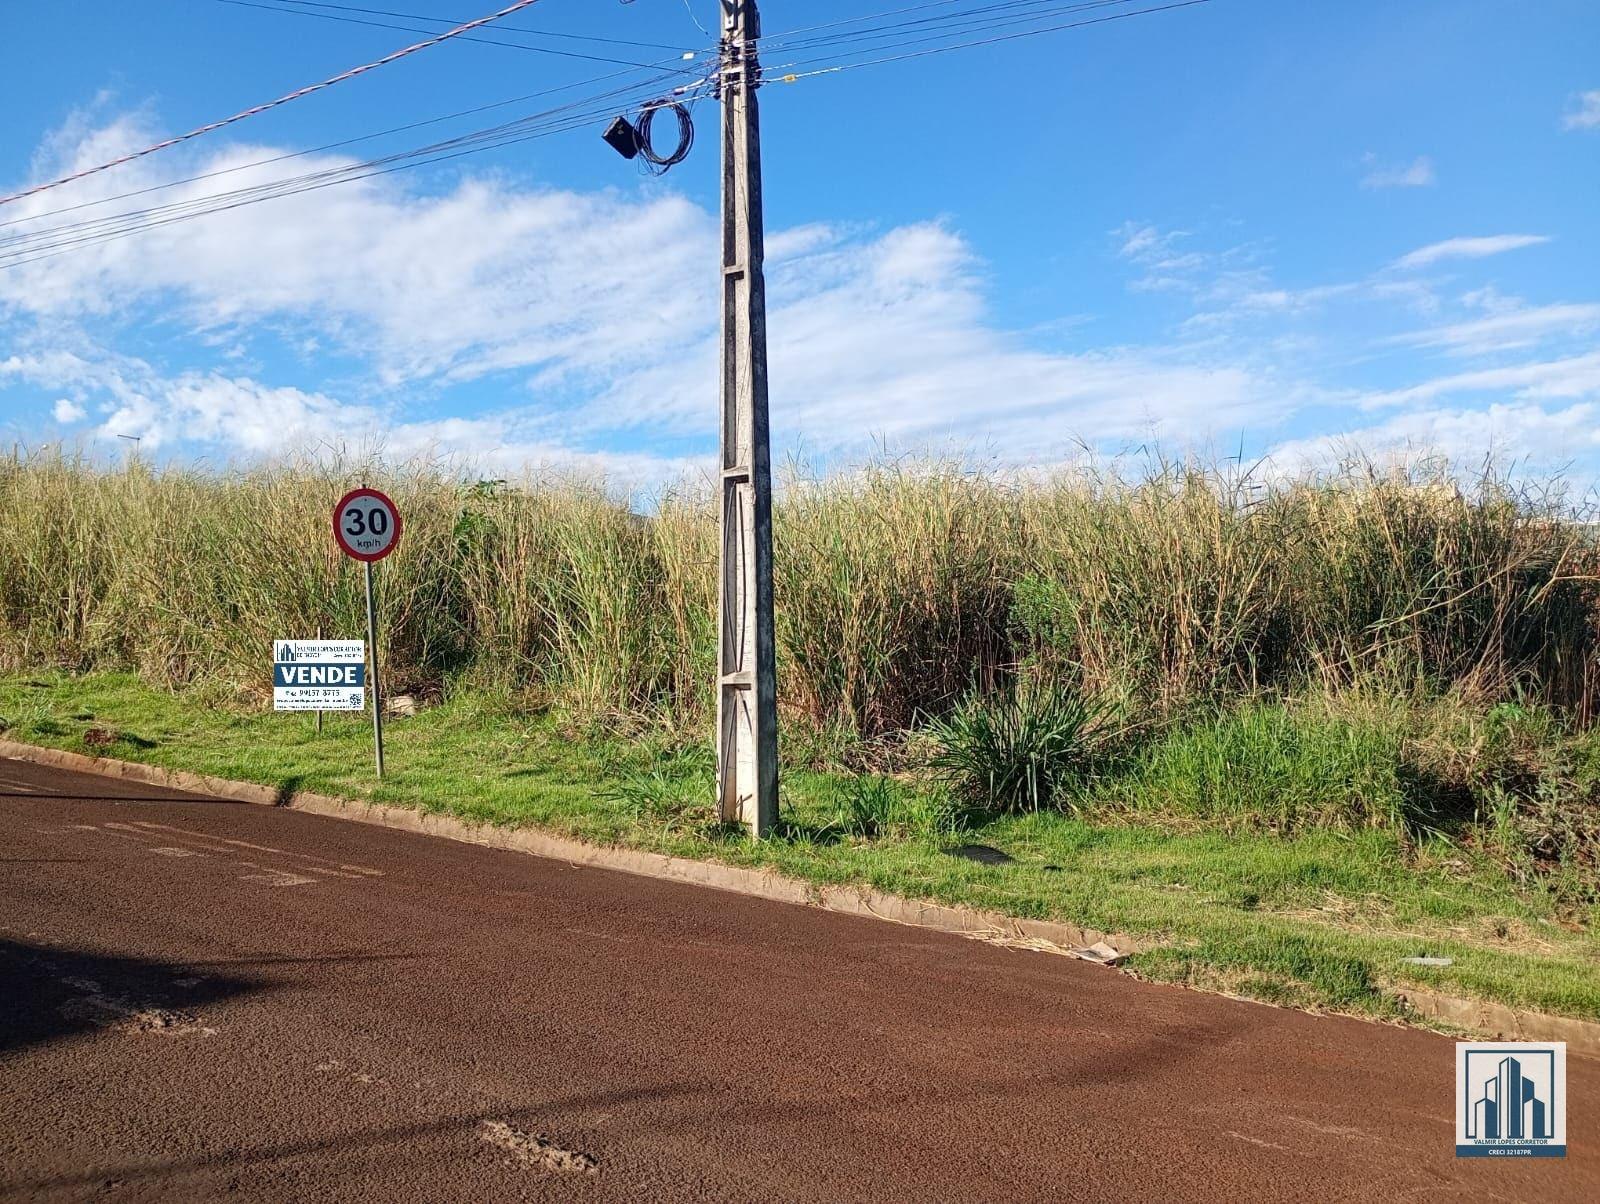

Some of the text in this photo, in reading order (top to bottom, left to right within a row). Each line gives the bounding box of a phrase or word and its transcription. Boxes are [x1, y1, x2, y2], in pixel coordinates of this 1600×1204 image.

[346, 508, 387, 535] 30
[357, 539, 381, 548] km/h
[281, 667, 356, 683] VENDE
